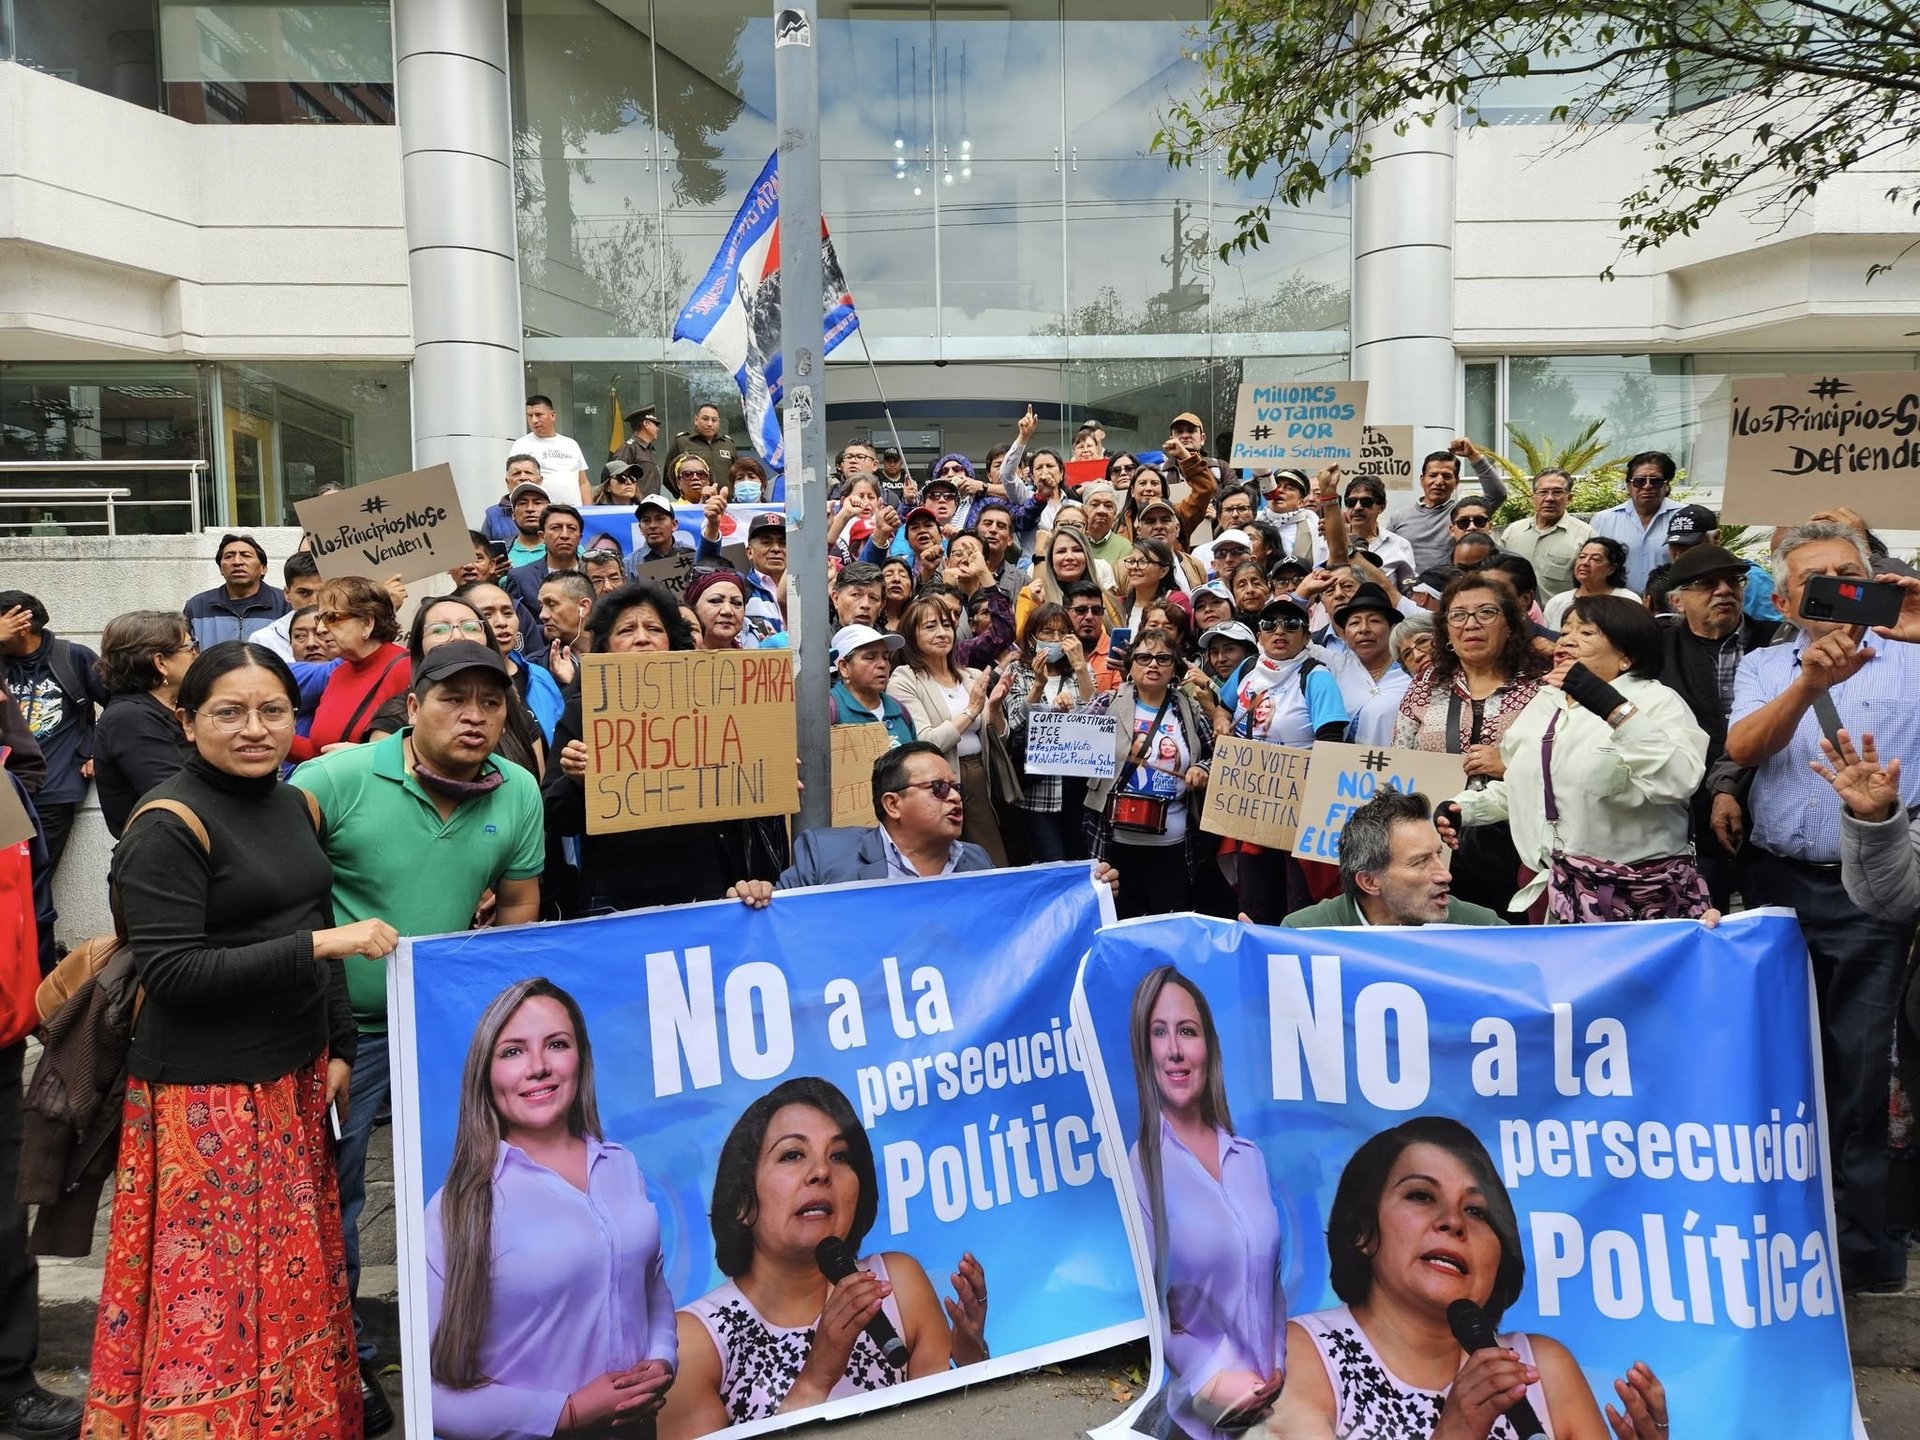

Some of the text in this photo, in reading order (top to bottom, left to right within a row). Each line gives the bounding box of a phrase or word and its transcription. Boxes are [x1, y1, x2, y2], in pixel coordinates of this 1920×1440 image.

[1288, 423, 1333, 439] POR
[1233, 443, 1286, 458] Priscila
[1360, 446, 1394, 458] DAD
[741, 658, 794, 704] PARA
[1033, 713, 1064, 723] CORTE
[1233, 745, 1253, 767] YO
[1261, 750, 1299, 779] VOTE
[1220, 766, 1299, 802] PRISCILA
[1337, 771, 1376, 800] NO
[824, 977, 866, 1051] a
[884, 957, 954, 1041] la
[1471, 1016, 1518, 1097] a
[1554, 1003, 1633, 1097] la
[1499, 1101, 1817, 1189] persecución
[1532, 1209, 1835, 1330] Política
